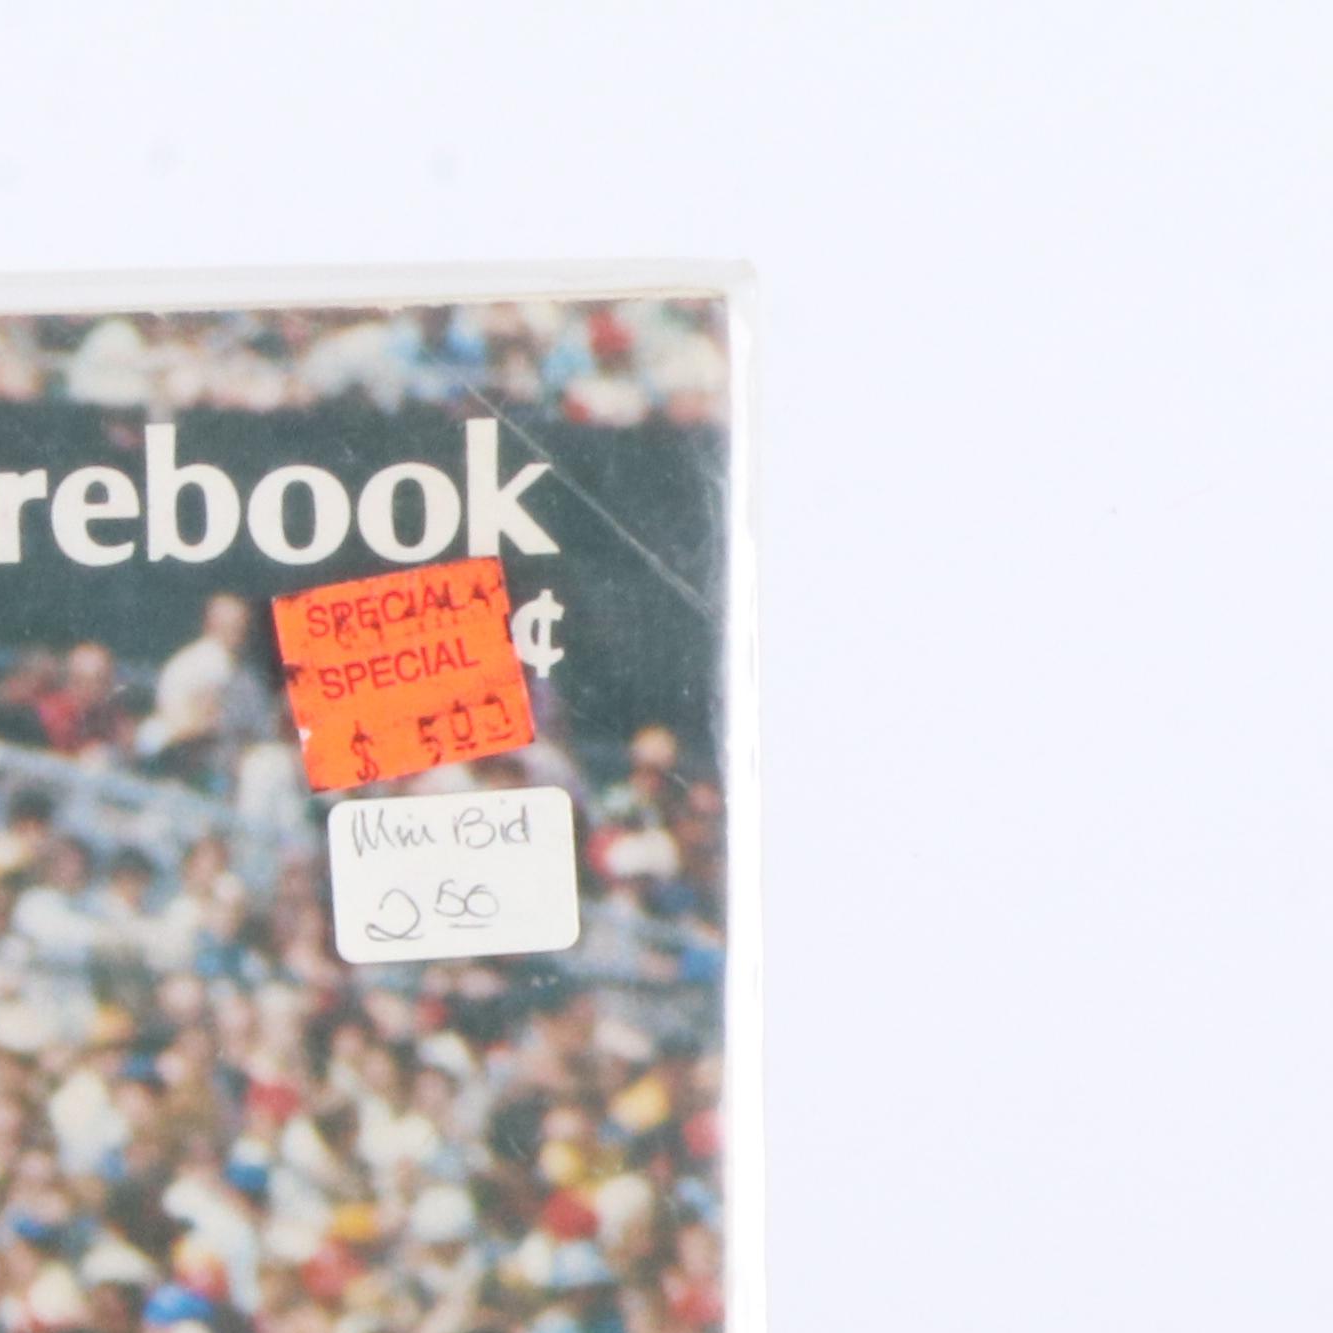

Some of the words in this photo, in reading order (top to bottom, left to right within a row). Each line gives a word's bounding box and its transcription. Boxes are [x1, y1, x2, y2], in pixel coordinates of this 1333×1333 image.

[305, 580, 469, 638] SPECIAL
[318, 638, 480, 699] SPECIAL
[453, 800, 531, 849] Bid
